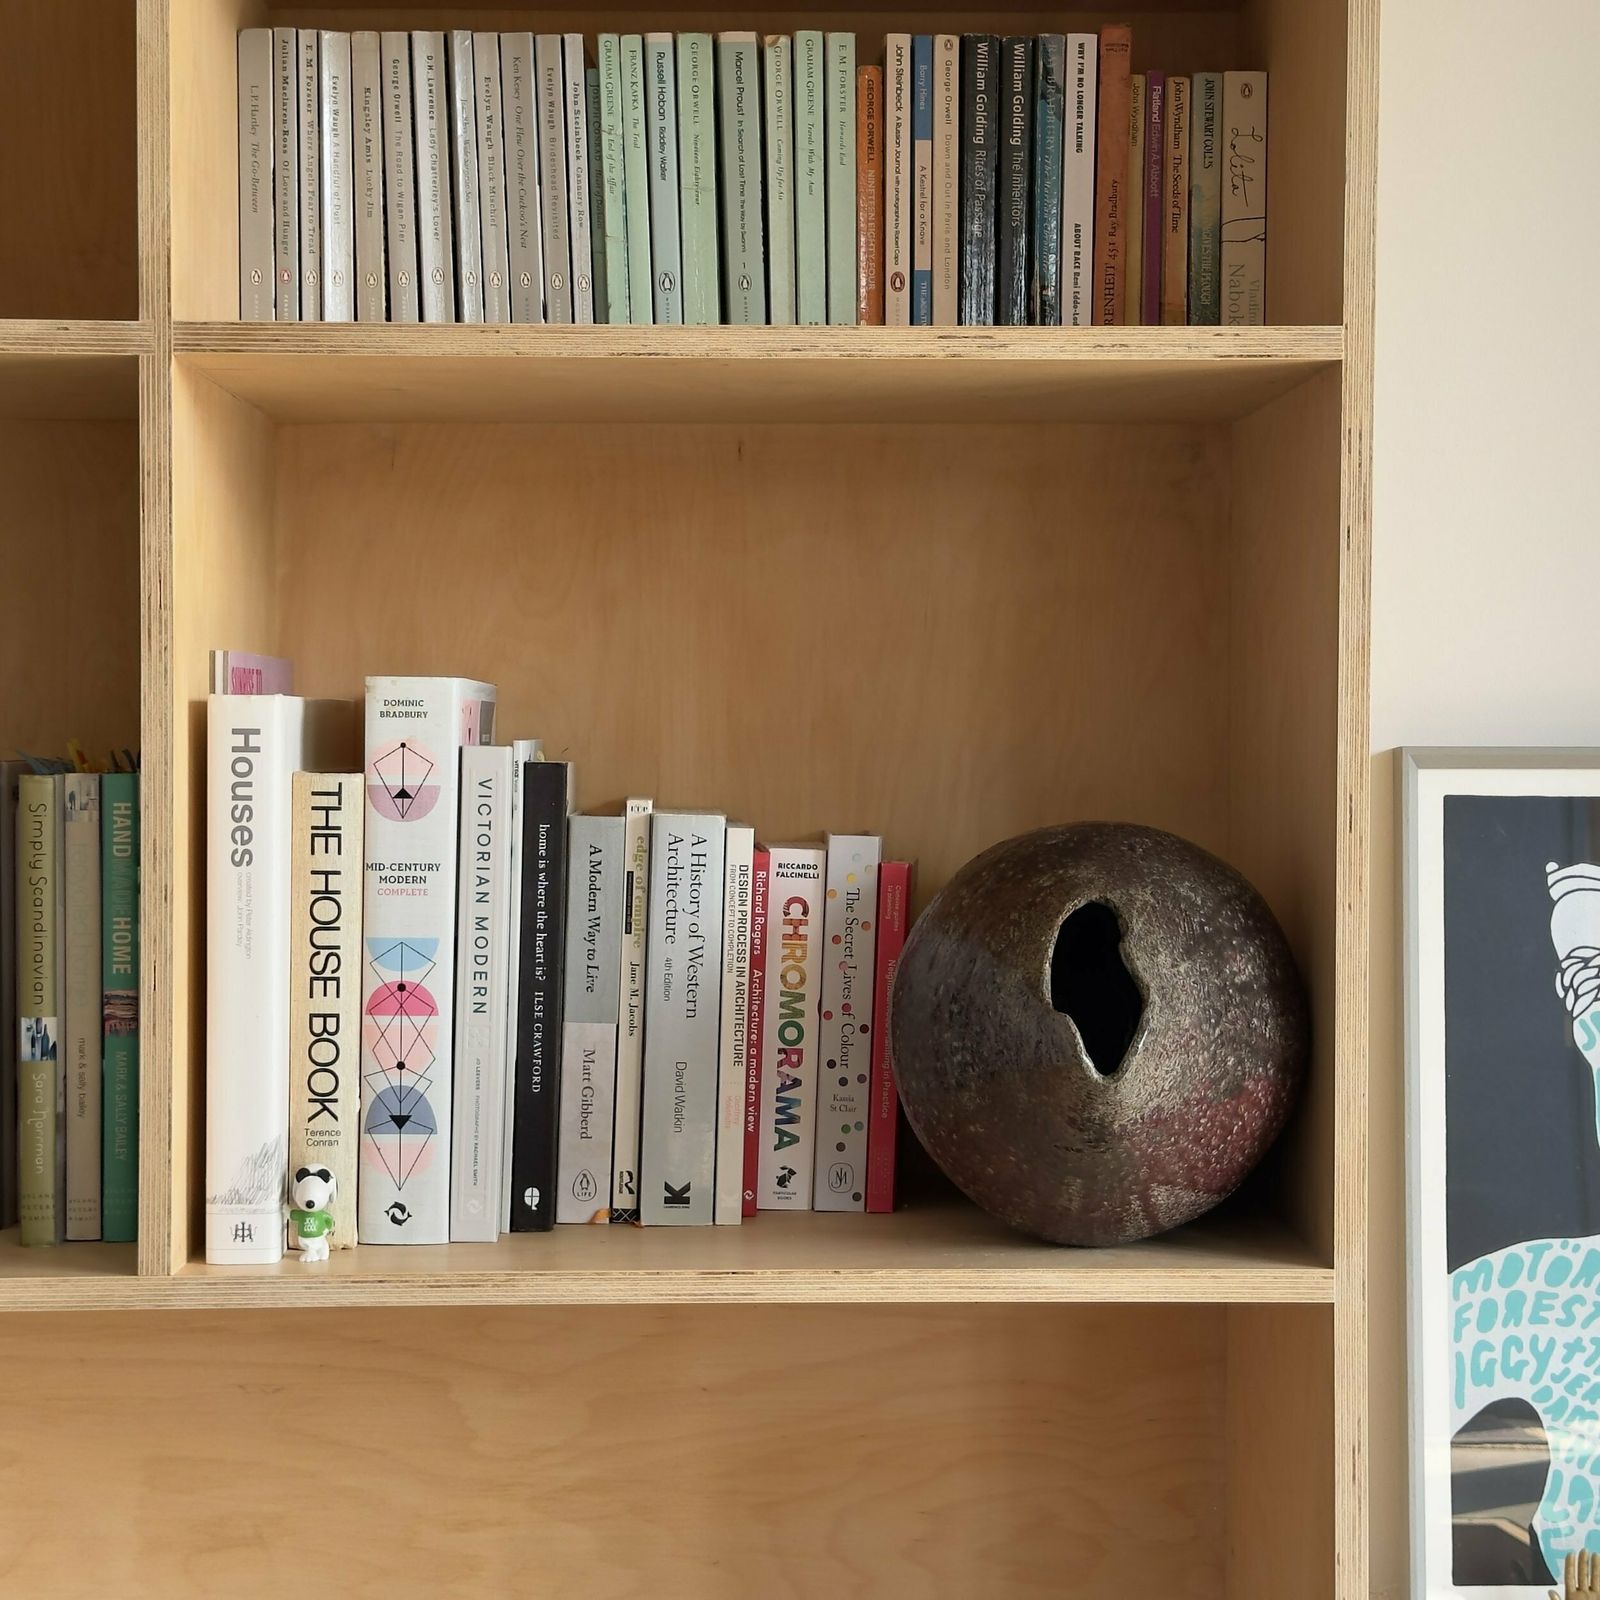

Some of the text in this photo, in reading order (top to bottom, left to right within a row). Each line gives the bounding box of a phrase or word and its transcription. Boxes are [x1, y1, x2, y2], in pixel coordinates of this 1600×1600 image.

[656, 52, 666, 84] Russell
[735, 52, 744, 84] Marcel
[895, 44, 904, 66] John
[1077, 43, 1085, 61] WHY
[391, 59, 400, 90] George
[895, 68, 904, 111] Steinbeck
[918, 65, 927, 110] Barry Hines
[944, 60, 952, 93] George
[1077, 78, 1084, 88] NO
[393, 94, 401, 123] Orwell
[427, 78, 435, 120] Lawrence
[658, 86, 667, 120] Hoban
[736, 87, 744, 116] Proust
[866, 80, 875, 120] GEORGE
[1076, 91, 1084, 119] LONGER
[1151, 86, 1162, 122] Flatland
[1204, 78, 1216, 137] JOHN STEWART
[428, 128, 436, 150] Lady
[658, 126, 666, 154] Riddley
[867, 122, 875, 163] ORWELL
[944, 134, 952, 159] Down
[972, 43, 988, 237] William Golding Rites of Passage
[1010, 43, 1024, 227] William Golding The Inheritors
[1076, 122, 1084, 153] TALKING
[1151, 124, 1160, 152] Edwin
[894, 150, 902, 174] Journal
[944, 162, 952, 178] and
[1171, 80, 1184, 233] John Wyndham The Seeds of Time
[1230, 126, 1263, 206] Lolita
[396, 178, 403, 187] to
[431, 154, 439, 211] Chatterley's
[867, 169, 876, 220] NINETEEN
[919, 174, 928, 199] Kestrel
[944, 181, 952, 199] Out
[1150, 165, 1159, 198] Abbott
[396, 190, 404, 219] Wigan
[919, 201, 928, 210] for
[944, 201, 952, 209] in
[919, 221, 927, 245] Knave
[944, 213, 952, 234] Paris
[944, 238, 952, 253] and
[1073, 251, 1081, 269] RACE
[230, 728, 261, 867] Houses
[366, 863, 441, 872] MID-CENTURY
[379, 876, 427, 884] MODERN
[28, 804, 48, 1005] Simply Scandinavian
[377, 888, 428, 896] COMPLETE
[472, 779, 493, 1014] VICTORIAN MODERN
[535, 824, 549, 980] home is where the heart is?
[631, 836, 646, 948] edge of empire
[664, 832, 684, 945] Architecture
[755, 871, 766, 914] Richard
[846, 888, 860, 913] The
[584, 844, 602, 993] A Modern Way to Live
[682, 833, 707, 1019] A History of Western
[728, 920, 734, 928] TO
[308, 782, 342, 1123] THE HOUSE BOOK
[751, 917, 764, 955] Rogers
[844, 917, 859, 958] Secret
[663, 957, 673, 1001] 4th Edition
[733, 864, 749, 1067] DESIGN PROCESS IN ARCHITECTURE
[842, 964, 857, 999] Lives
[628, 962, 640, 1037] Jane M. Jacobs
[750, 969, 762, 1045] Architecture:
[773, 896, 809, 1152] CHROMORAMA
[531, 991, 544, 1093] ILSE CRAWFORD
[840, 1023, 854, 1069] Colour
[32, 1073, 45, 1104] Sara
[580, 1048, 596, 1139] Matt Gibberd
[673, 1061, 687, 1133] David Watkin
[748, 1058, 759, 1102] modern
[304, 1128, 342, 1137] Terence
[747, 1106, 755, 1132] view
[28, 1110, 49, 1174] Norrman
[306, 1138, 339, 1147] Conran
[1455, 1334, 1556, 1409] IGGY
